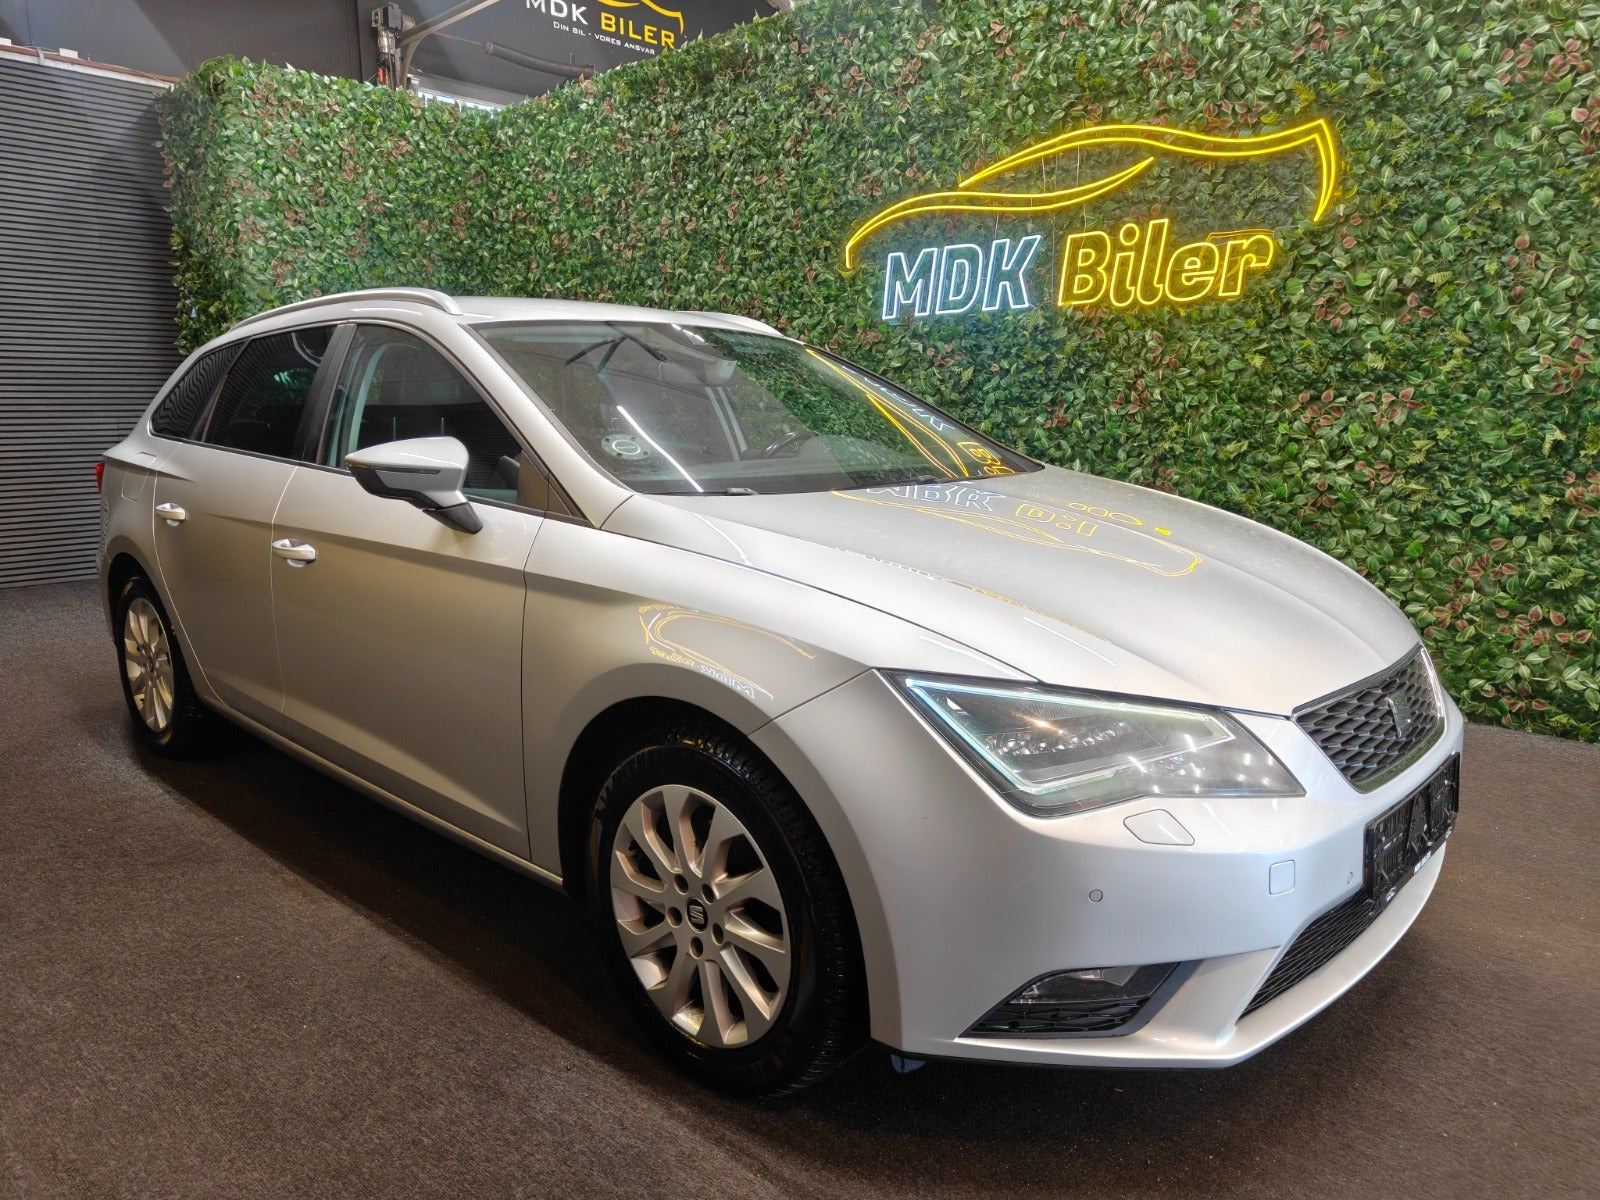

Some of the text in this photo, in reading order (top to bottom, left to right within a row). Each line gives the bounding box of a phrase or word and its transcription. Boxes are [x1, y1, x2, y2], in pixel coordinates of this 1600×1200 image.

[553, 21, 569, 31] DIN
[572, 27, 586, 36] BIL
[594, 33, 621, 46] VORES
[624, 41, 655, 55] ANSVAR
[600, 11, 675, 50] BILER
[881, 218, 1274, 320] MDK Biler
